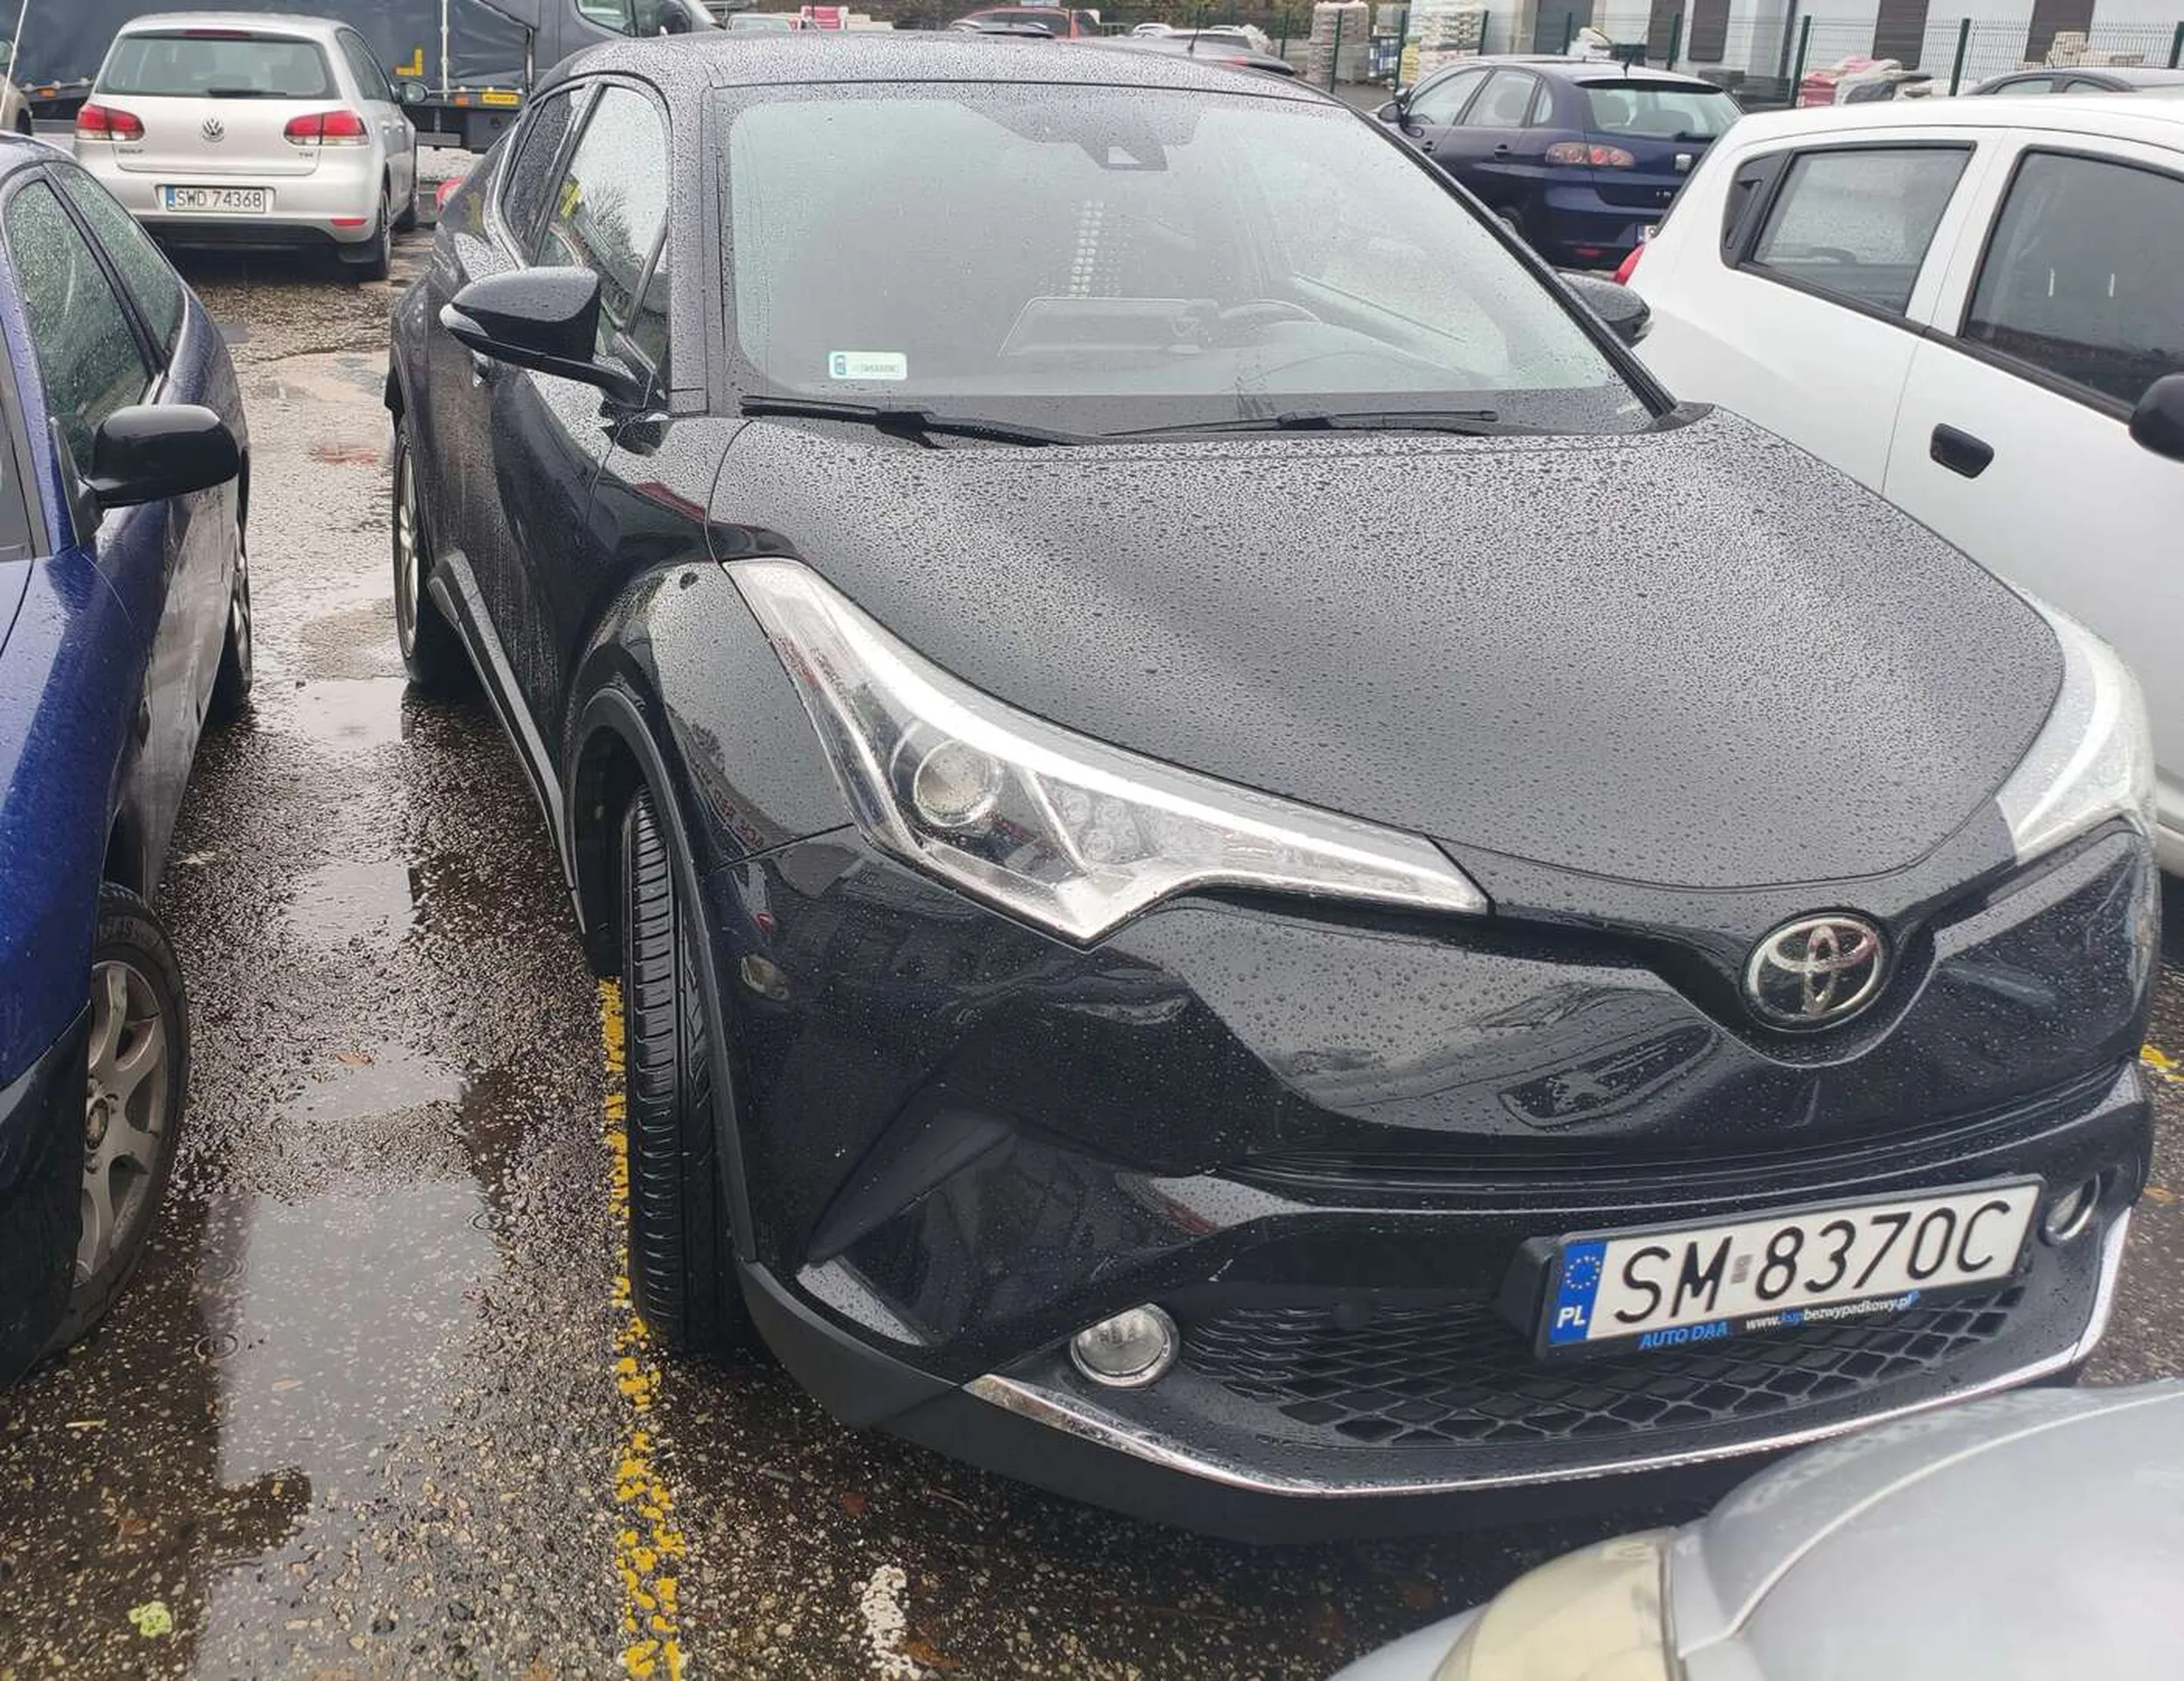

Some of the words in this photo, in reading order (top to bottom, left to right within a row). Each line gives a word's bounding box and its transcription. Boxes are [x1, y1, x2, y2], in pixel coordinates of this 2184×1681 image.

[176, 190, 207, 207] SWD
[212, 190, 262, 208] 74368
[1614, 1235, 1734, 1325] SM
[1754, 1200, 2012, 1302] 8370C
[1556, 1305, 1588, 1328] PL
[1639, 1327, 1690, 1350] AUTO
